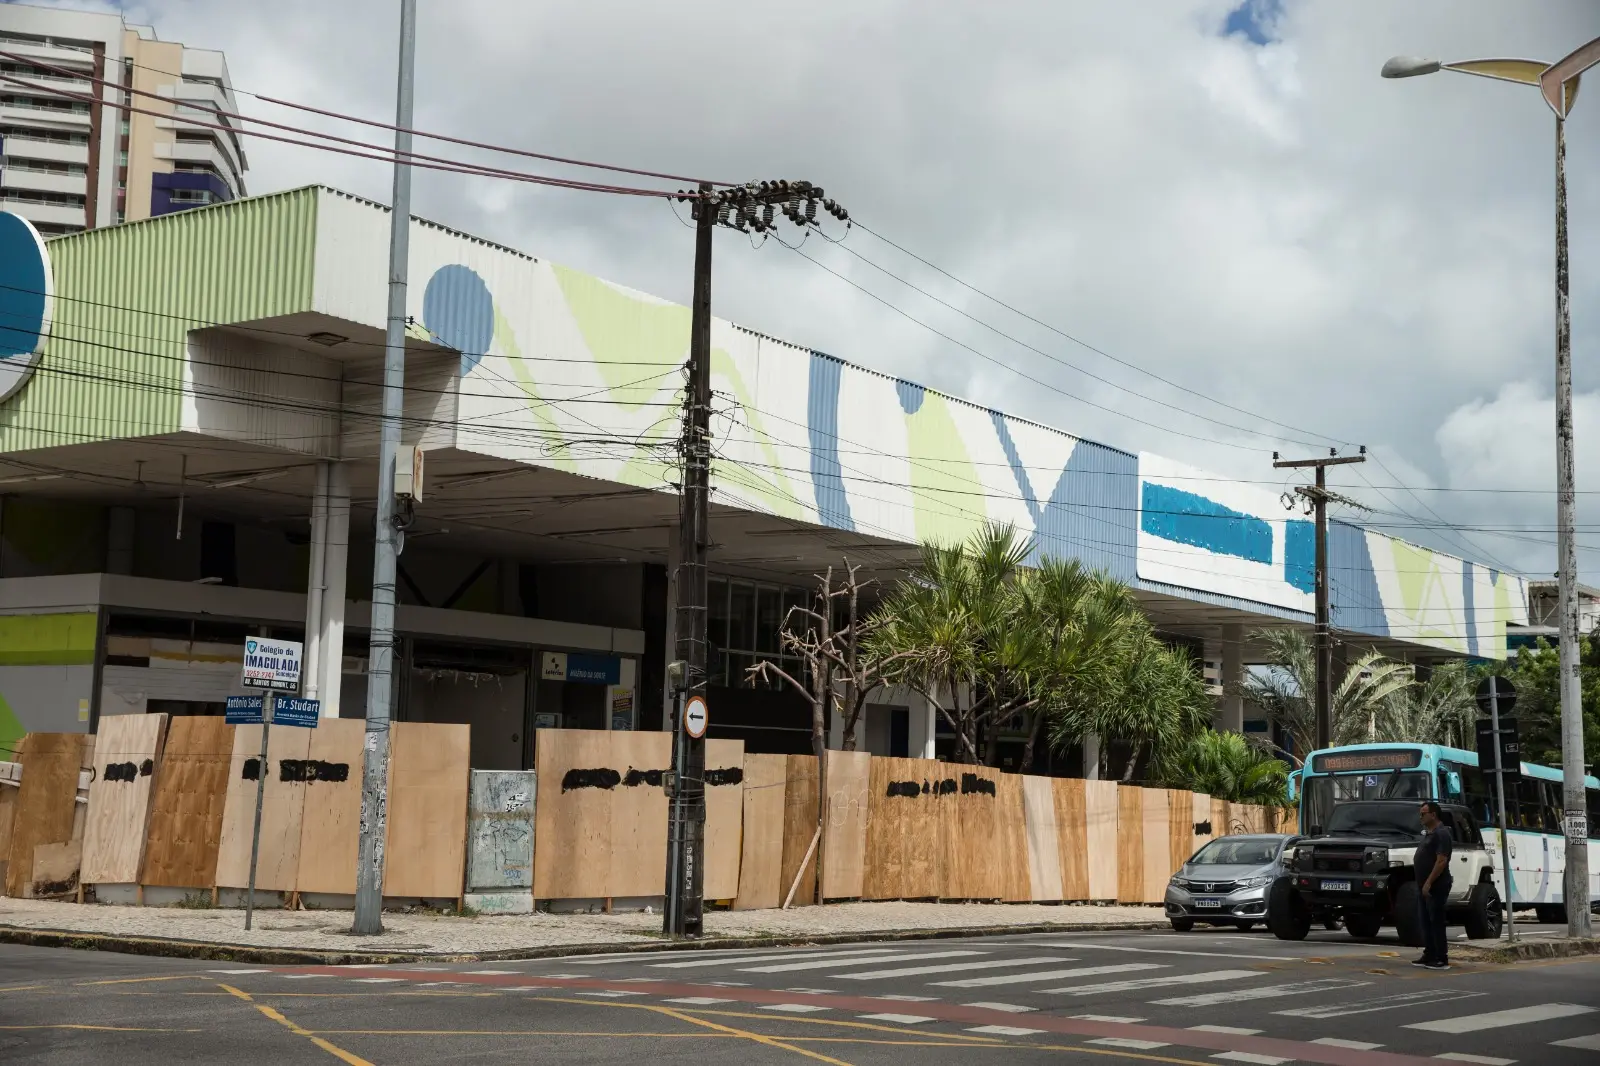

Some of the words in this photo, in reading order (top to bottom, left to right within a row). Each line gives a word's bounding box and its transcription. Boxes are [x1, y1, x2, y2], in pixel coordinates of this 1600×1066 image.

[286, 648, 294, 656] da
[245, 654, 299, 672] IMACULADA
[248, 697, 262, 708] Sales
[277, 699, 288, 709] Br.
[290, 700, 319, 712] Studart
